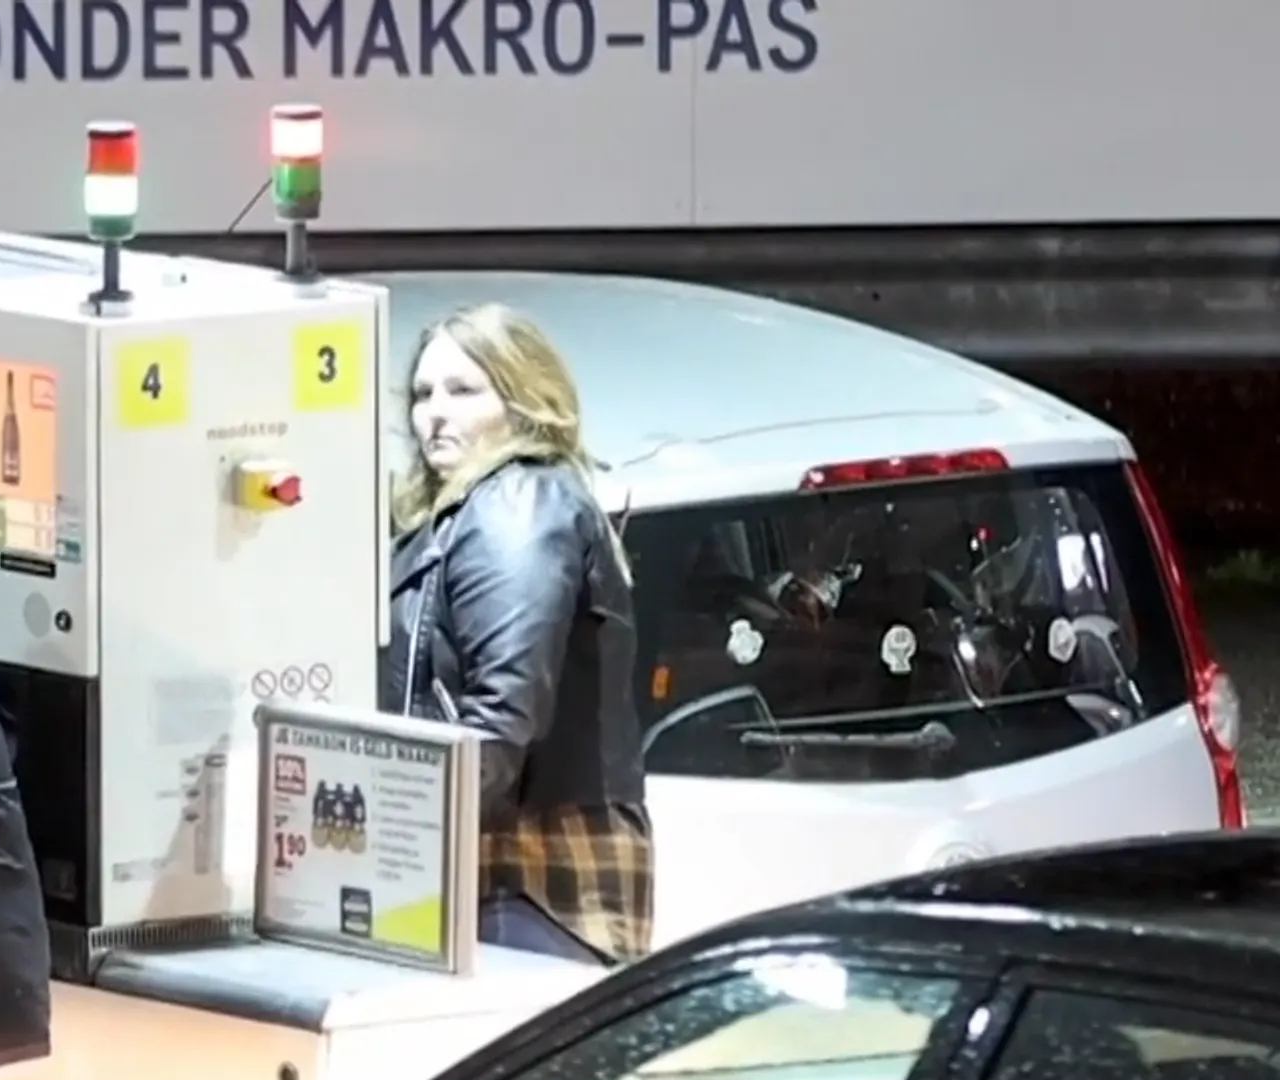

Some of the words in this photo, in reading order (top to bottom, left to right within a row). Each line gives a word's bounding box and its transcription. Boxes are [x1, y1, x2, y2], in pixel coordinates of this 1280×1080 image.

[282, 0, 819, 77] MAKRO-PAS
[141, 362, 162, 400] 4
[317, 345, 338, 384] 3
